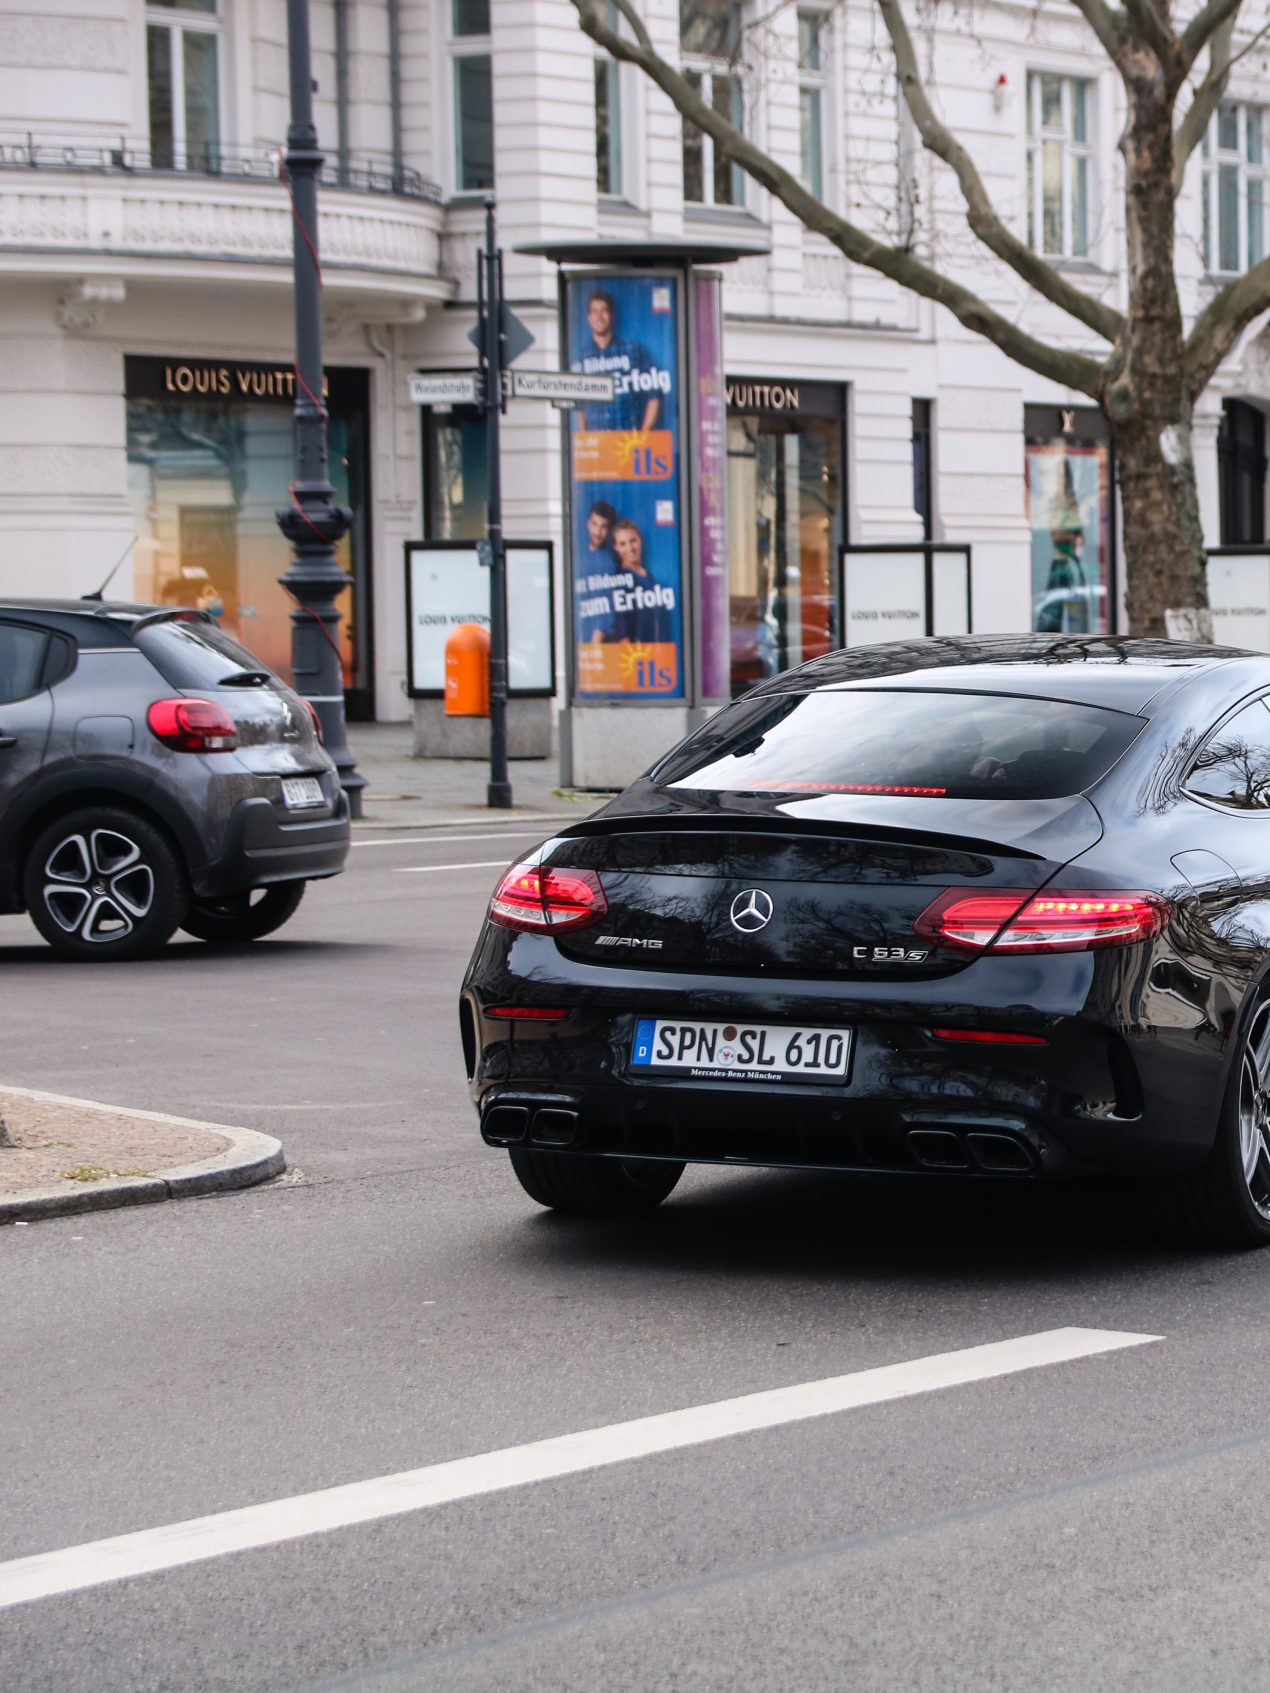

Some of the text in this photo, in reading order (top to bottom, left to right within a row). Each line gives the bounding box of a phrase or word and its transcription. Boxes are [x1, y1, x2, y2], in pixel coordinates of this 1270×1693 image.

[583, 355, 631, 373] Bildung
[165, 365, 329, 397] LOUIS VUITTN
[414, 381, 471, 396] Wielandstraße
[517, 375, 609, 394] Kurfürstendamm
[614, 366, 672, 394] Erfolg
[724, 384, 799, 409] VUITTON
[633, 447, 669, 476] ils
[588, 572, 635, 592] Bildung
[579, 583, 676, 618] zum Erfolg
[418, 613, 448, 626] LOUIS
[851, 609, 920, 620] LOUIS VUITTON
[636, 659, 673, 688] ils
[616, 937, 663, 949] AMG
[853, 946, 867, 958] C
[638, 1046, 648, 1057] D
[656, 1025, 843, 1069] SPN SL 610
[690, 1068, 782, 1080] Mercedes-Benz München
